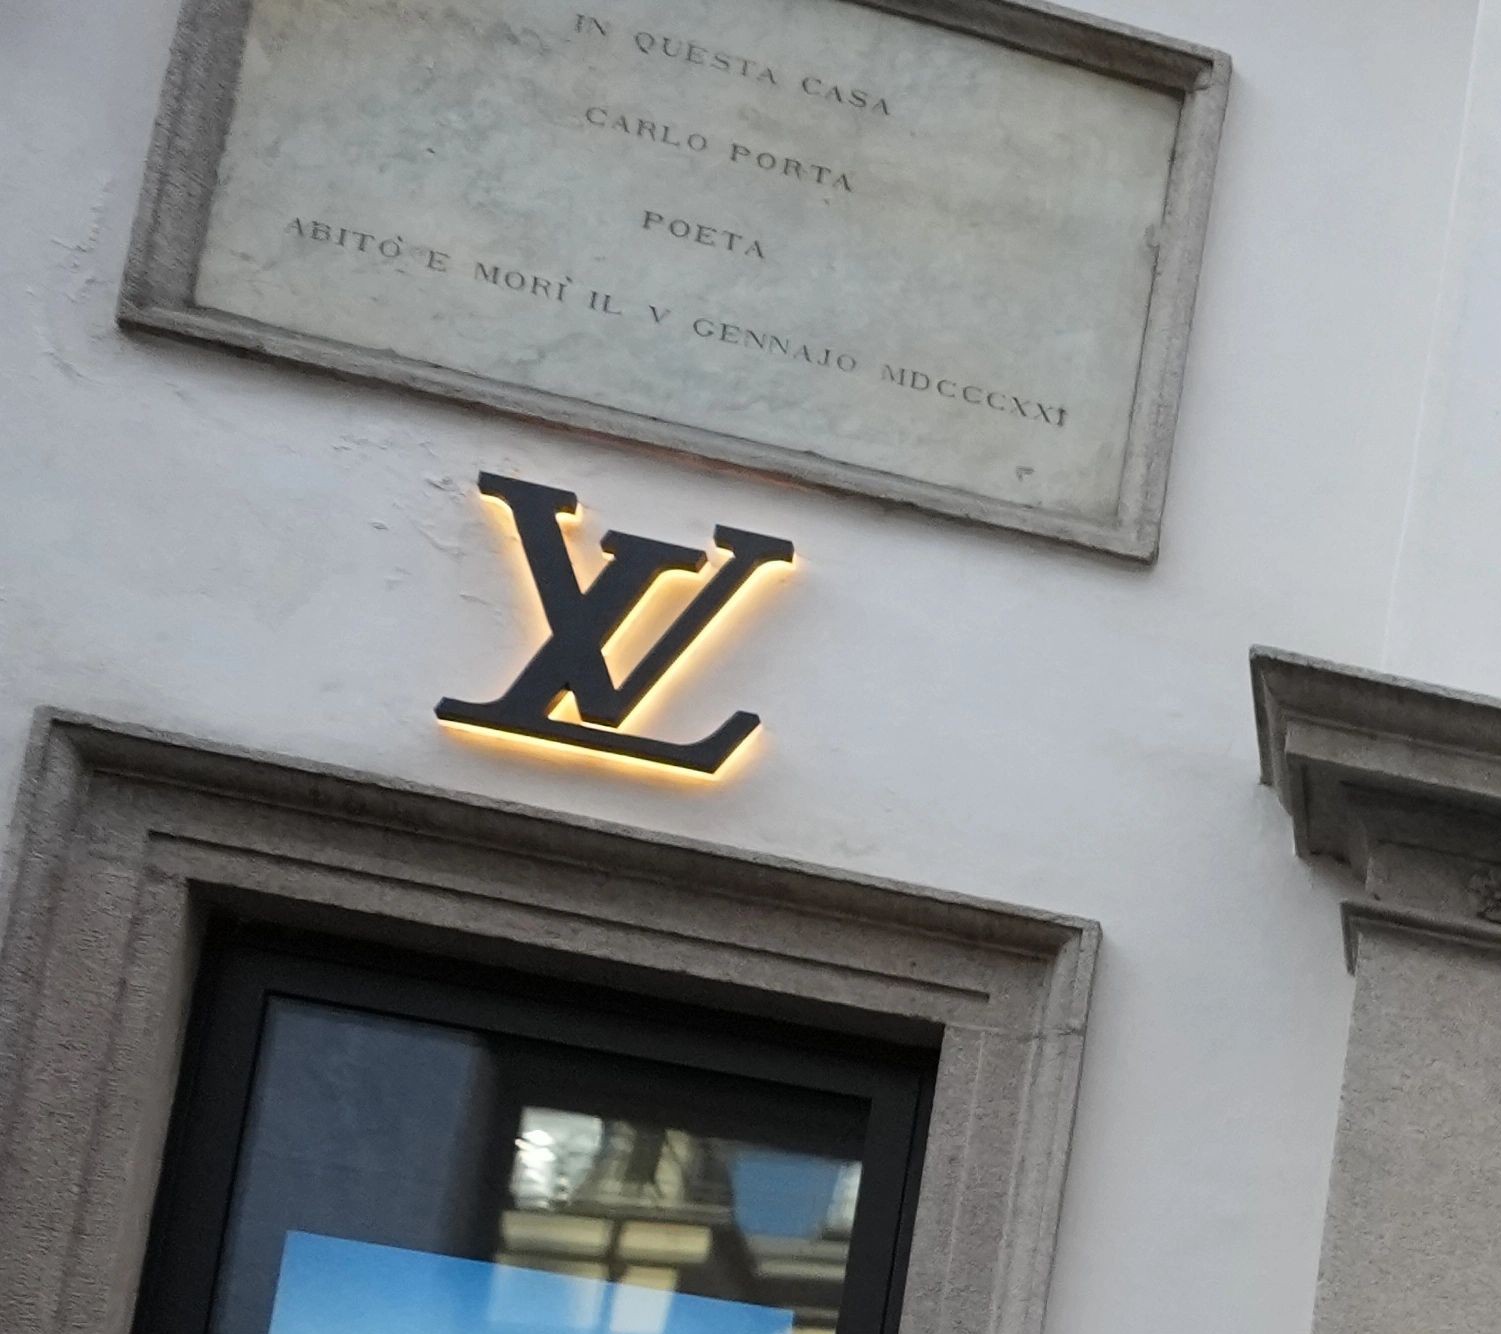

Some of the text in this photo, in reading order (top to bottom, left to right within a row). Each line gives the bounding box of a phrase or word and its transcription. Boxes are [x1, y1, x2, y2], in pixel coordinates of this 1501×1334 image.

[575, 14, 891, 117] IN QUESTA CASA
[585, 106, 853, 193] CARLO PORTA
[643, 209, 765, 260] POETA
[426, 249, 450, 273] E
[589, 290, 623, 317] IL
[648, 304, 672, 324] V
[692, 317, 857, 373] GENNAJO
[881, 363, 1070, 428] MDCCCXXI
